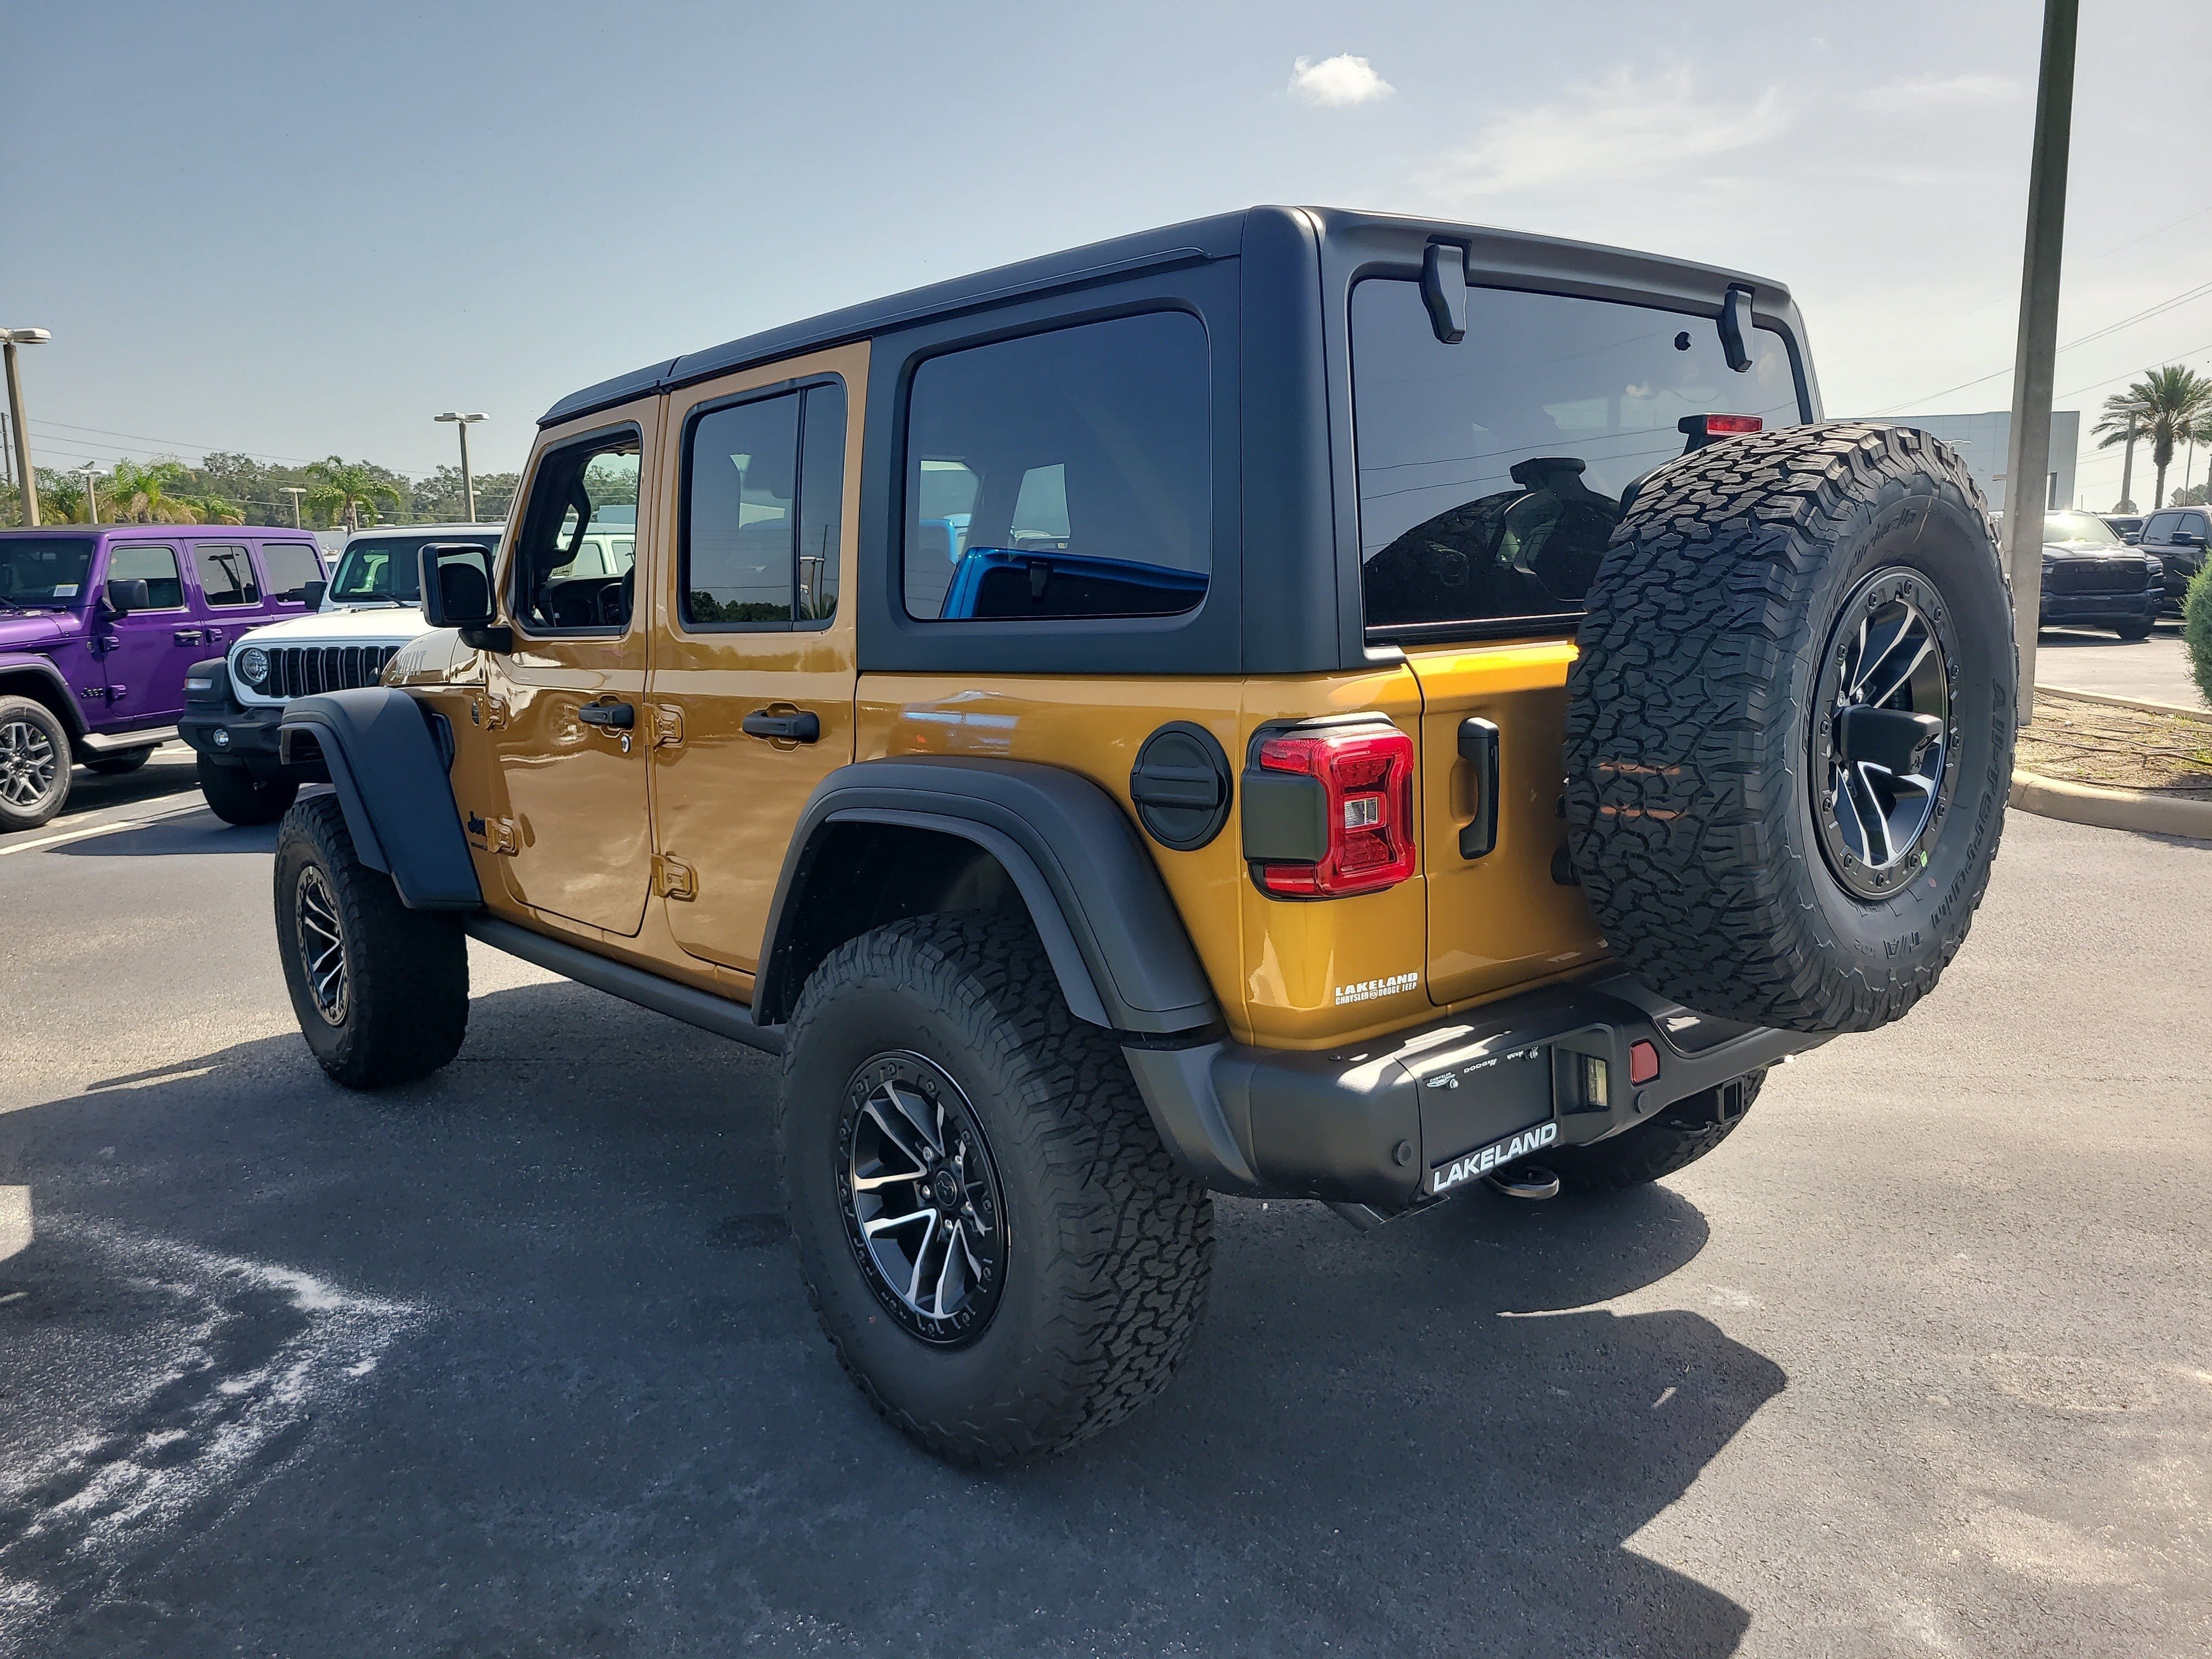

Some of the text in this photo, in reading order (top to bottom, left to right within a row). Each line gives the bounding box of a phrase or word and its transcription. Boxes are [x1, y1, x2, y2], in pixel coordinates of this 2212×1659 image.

[1335, 972, 1418, 997] LAKELAND
[1335, 982, 1417, 1006] CHRYSLER DODGE JEEP
[1433, 1122, 1557, 1193] LAKELAND
